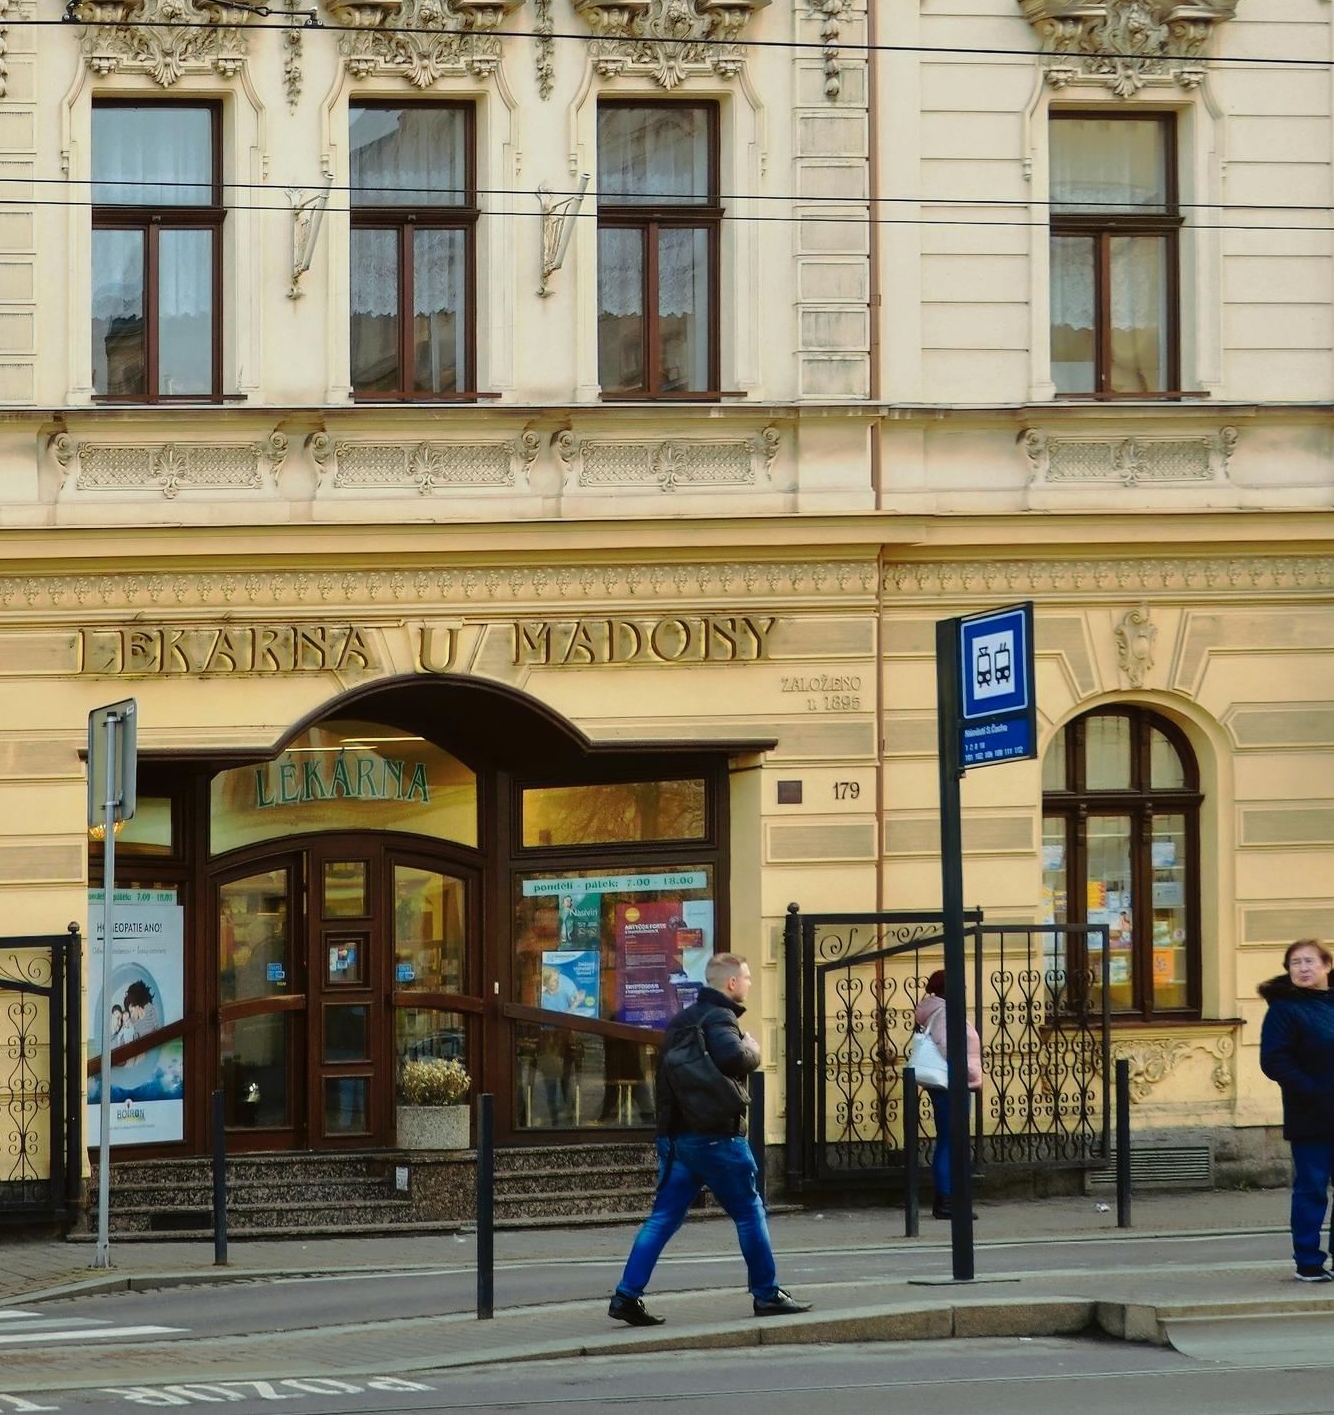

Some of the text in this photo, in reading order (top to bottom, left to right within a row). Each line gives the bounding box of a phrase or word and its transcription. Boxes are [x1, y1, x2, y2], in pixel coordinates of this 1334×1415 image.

[418, 627, 459, 674] U
[513, 617, 778, 666] MADONY
[780, 674, 862, 692] ZALOŽENO
[254, 747, 432, 809] LÉKÁRNA
[832, 782, 861, 801] 179
[626, 878, 651, 888] 7.00
[662, 875, 695, 886] 18.00
[96, 923, 143, 934] HEOPATIE
[100, 1375, 438, 1407] POZOR
